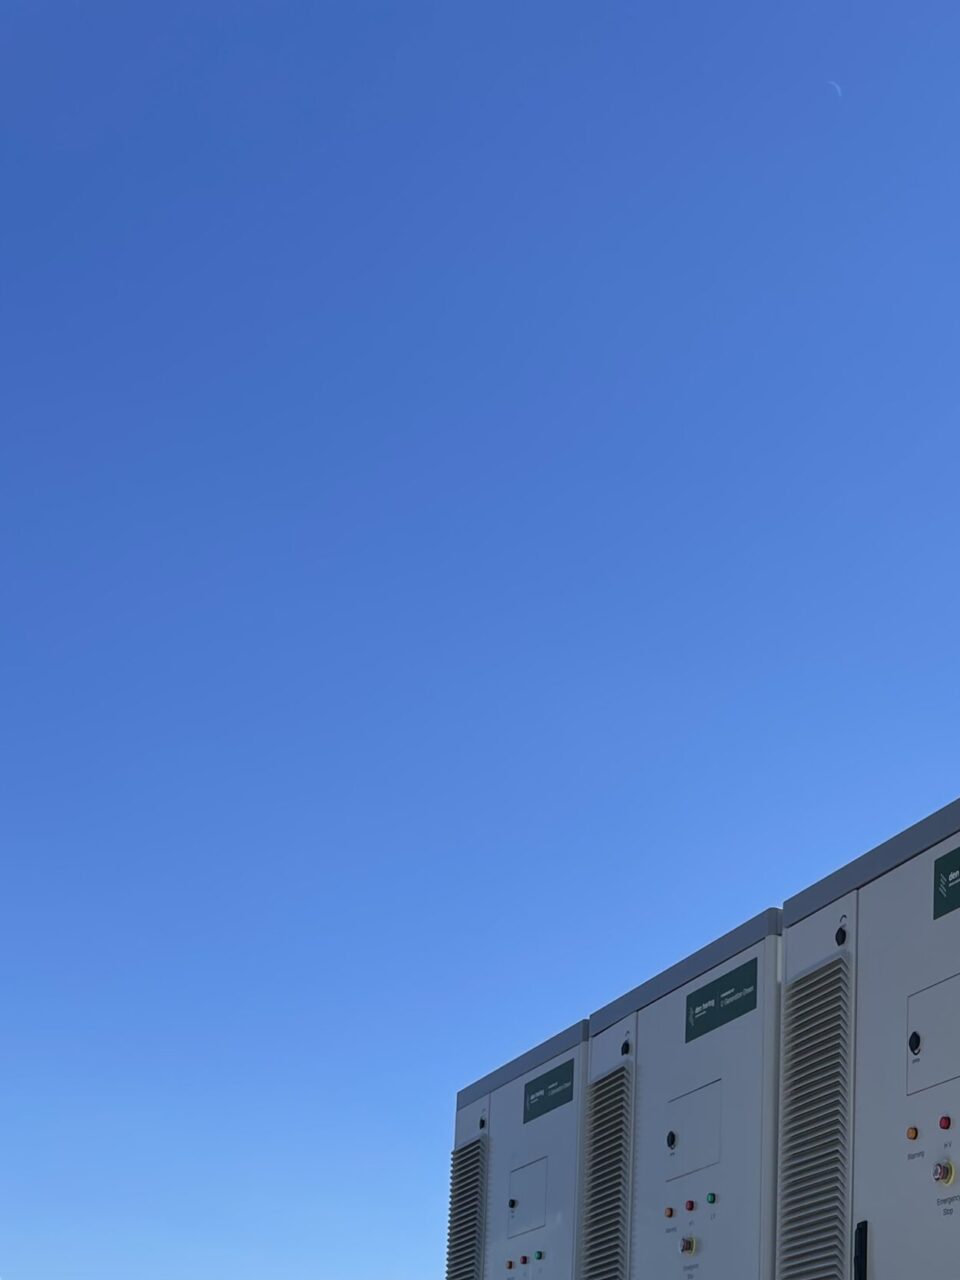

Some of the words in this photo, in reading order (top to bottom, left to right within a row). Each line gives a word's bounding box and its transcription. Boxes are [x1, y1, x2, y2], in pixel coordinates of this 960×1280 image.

[948, 870, 960, 881] den
[936, 1194, 960, 1206] Emergency
[943, 1208, 954, 1216] Stop
